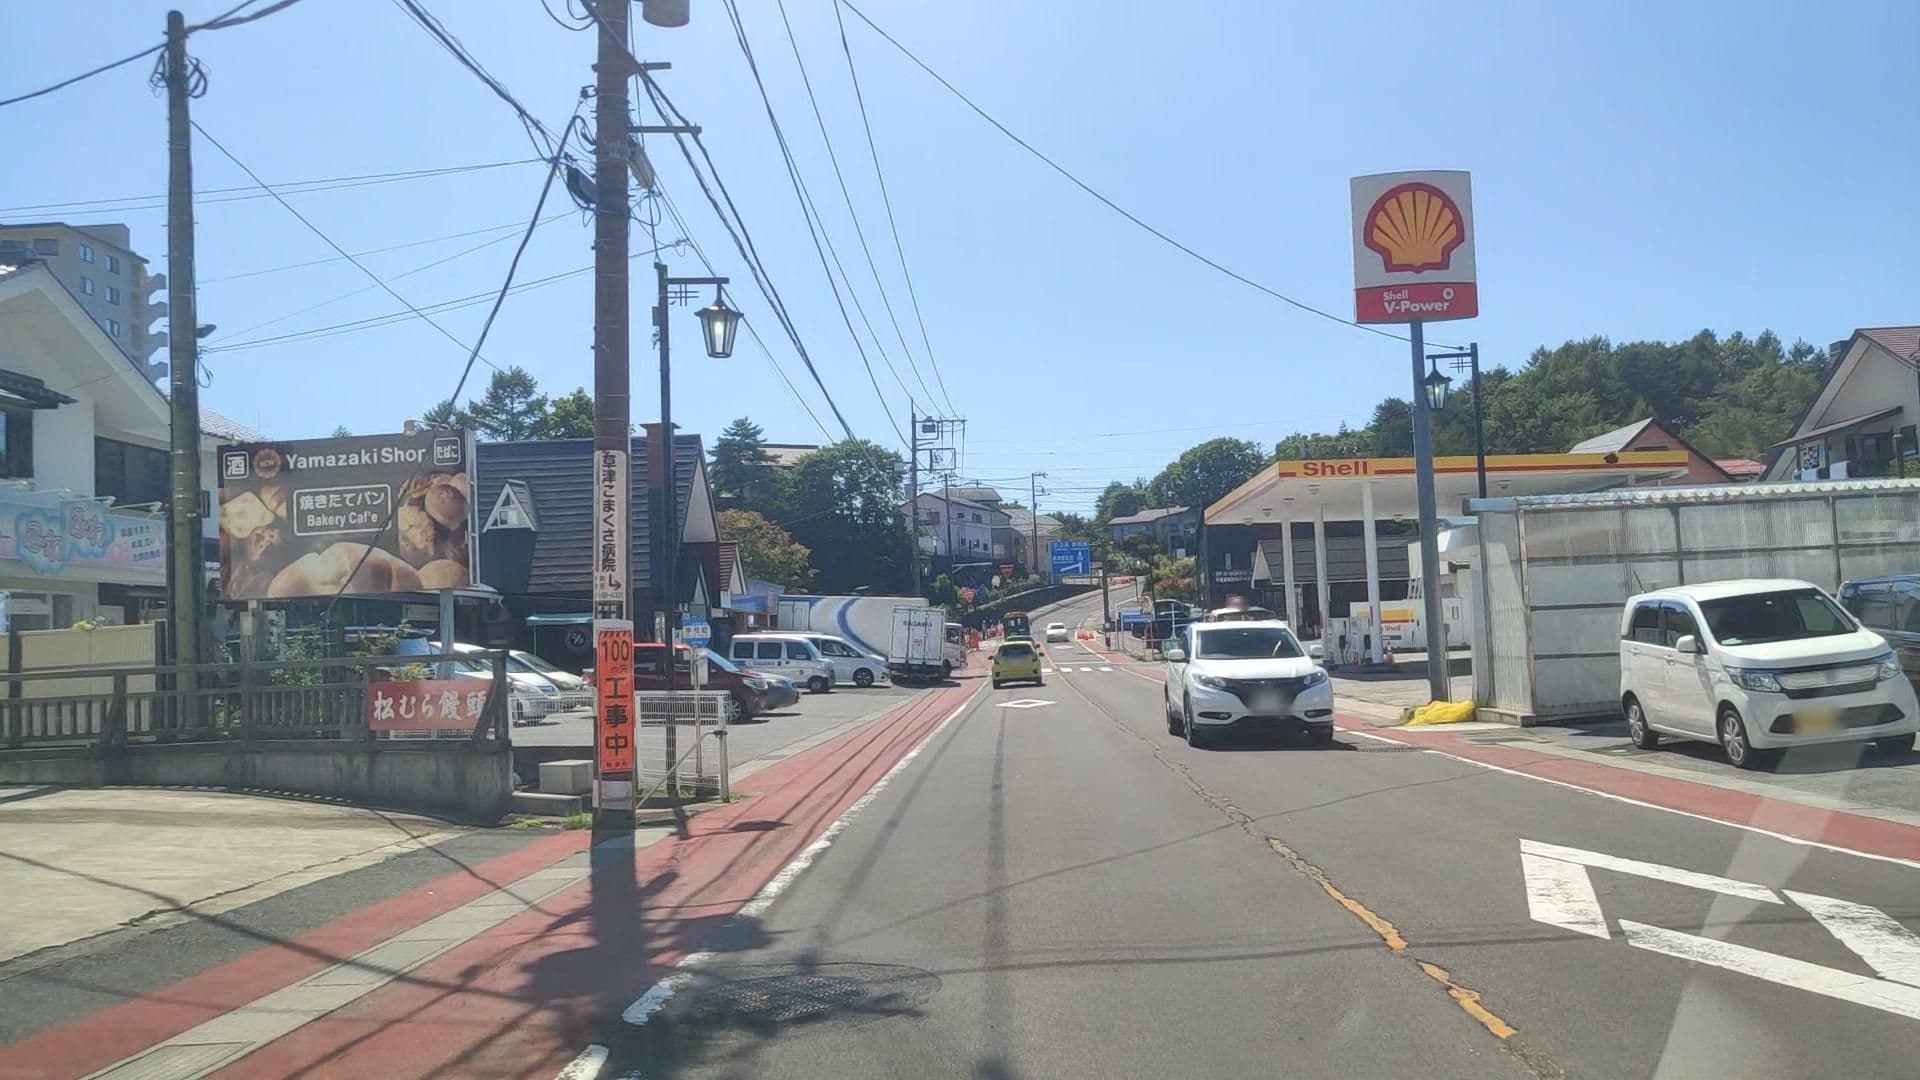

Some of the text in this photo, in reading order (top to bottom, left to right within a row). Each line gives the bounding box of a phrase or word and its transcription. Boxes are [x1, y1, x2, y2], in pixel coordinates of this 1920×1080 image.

[1383, 290, 1409, 301] Shell
[1383, 301, 1451, 314] V-Power
[226, 455, 245, 476] 酒
[286, 447, 378, 470] Yamazaki
[1303, 460, 1369, 477] Shell
[300, 491, 385, 511] 焼きたてパン
[306, 512, 345, 528] Bakery
[602, 450, 617, 573] 草津こまくさ病院
[601, 639, 629, 662] 100
[604, 677, 628, 757] 工事中
